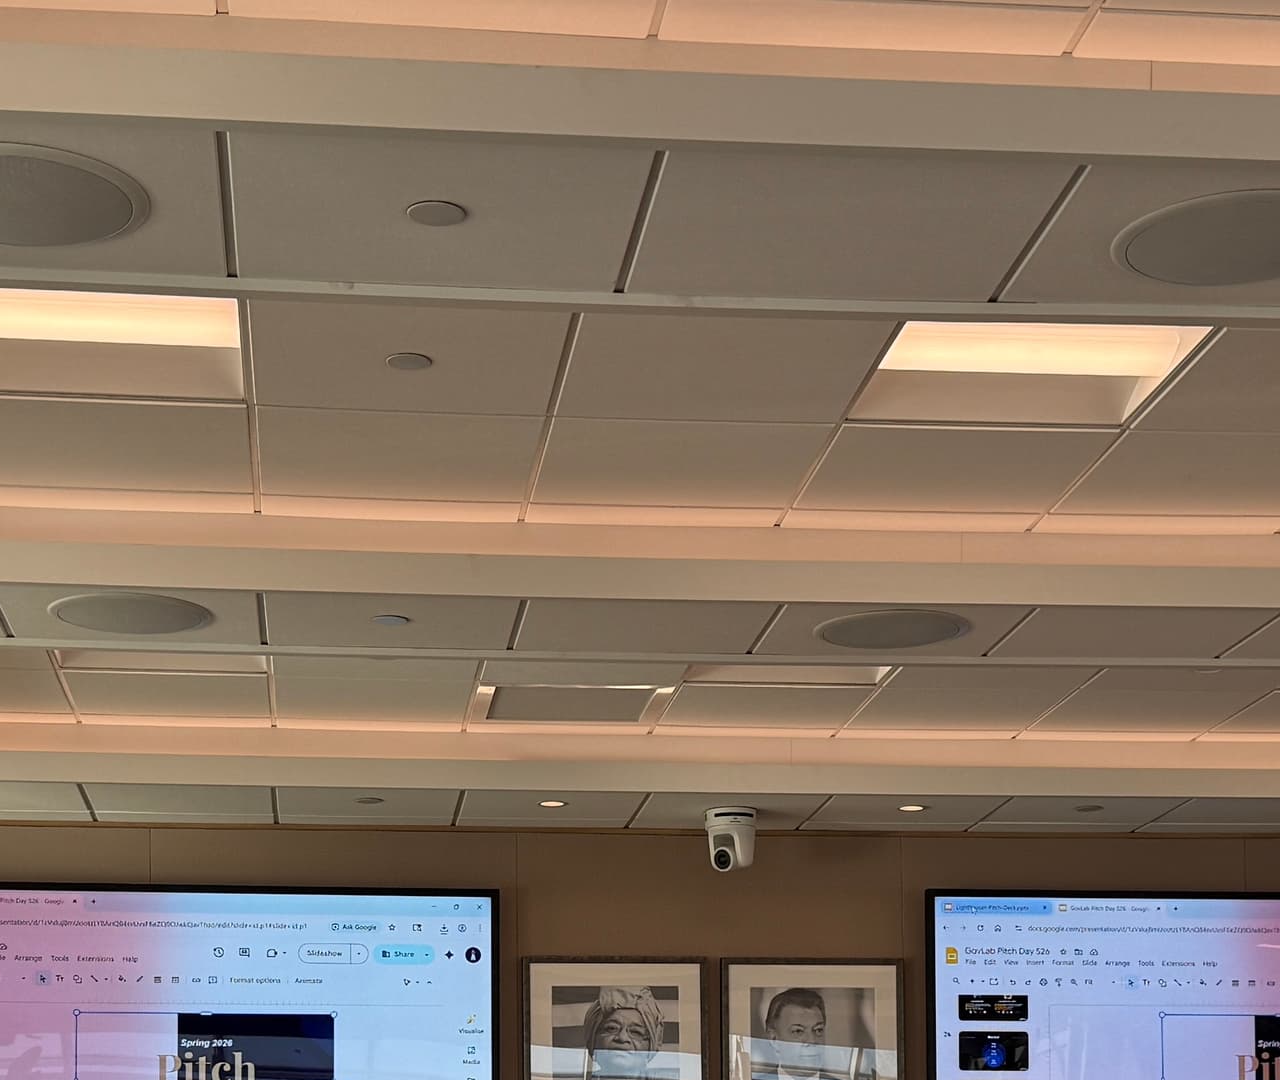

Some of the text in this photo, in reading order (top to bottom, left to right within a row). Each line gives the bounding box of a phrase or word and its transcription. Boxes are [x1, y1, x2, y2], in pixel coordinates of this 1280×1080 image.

[355, 924, 378, 932] Google
[964, 946, 996, 955] GovLab
[997, 947, 1018, 955] Pitch
[1018, 947, 1035, 957] Day
[14, 954, 43, 964] Arrange
[77, 955, 115, 963] Extensions
[122, 956, 139, 964] Help
[1082, 959, 1098, 967] Slide
[1105, 960, 1131, 969] Arrange
[1162, 960, 1196, 968] Extensions
[1203, 961, 1219, 969] Help
[255, 977, 282, 986] options
[180, 1038, 233, 1049] Spring 2026
